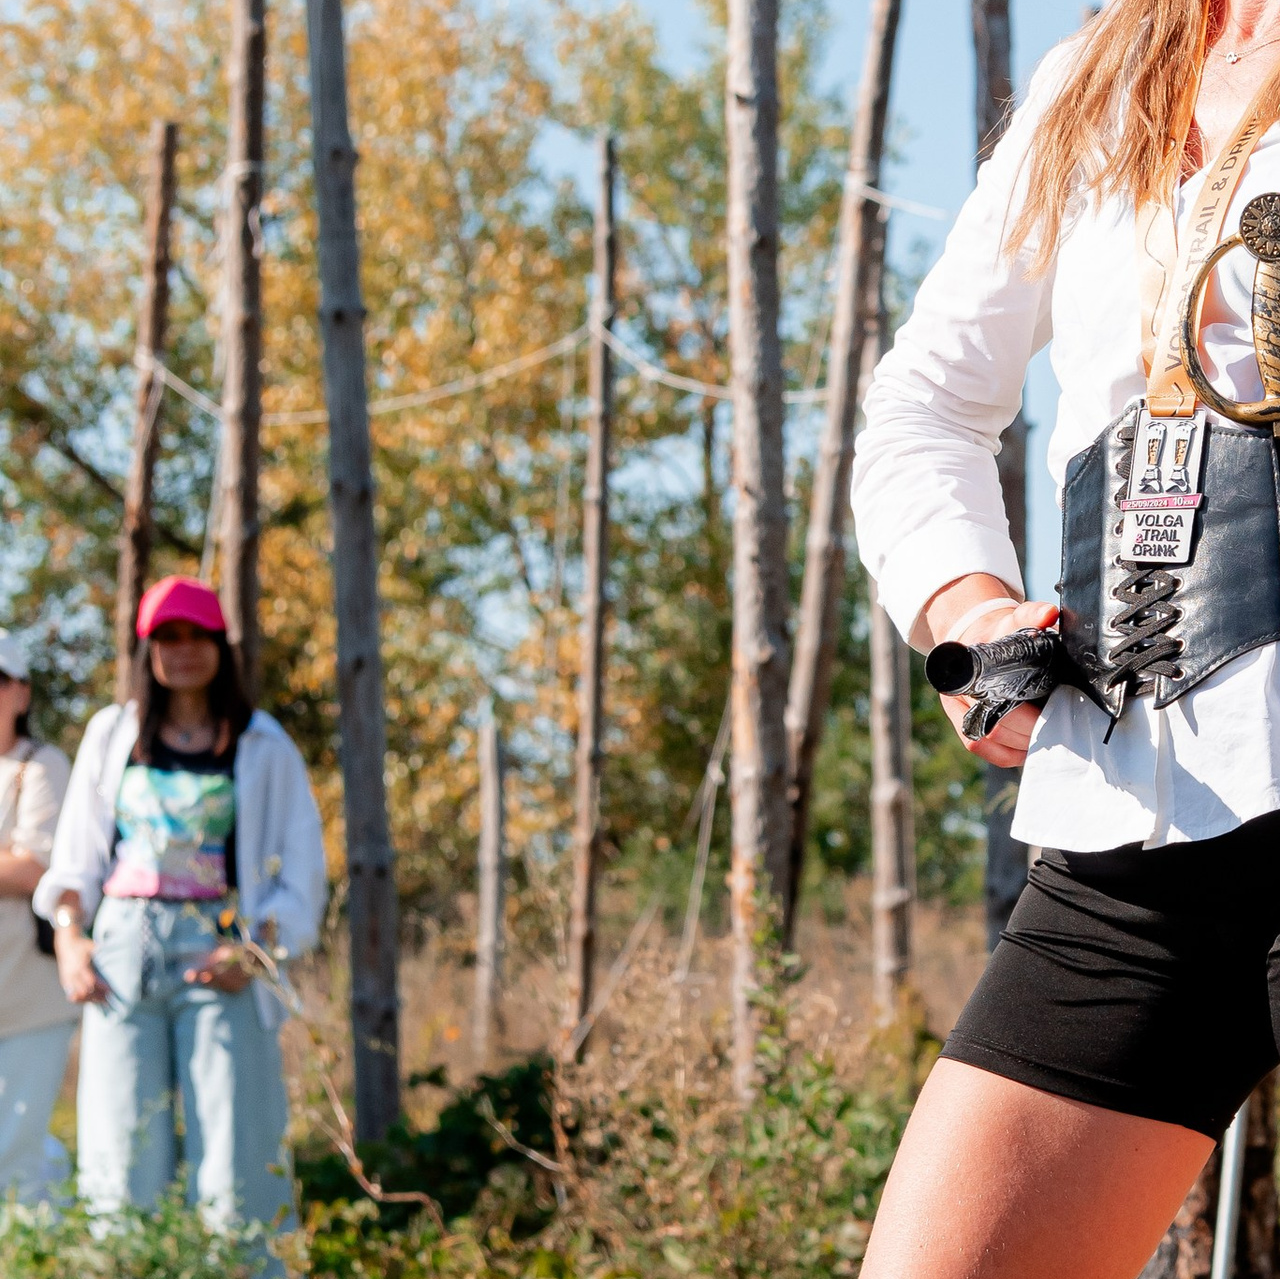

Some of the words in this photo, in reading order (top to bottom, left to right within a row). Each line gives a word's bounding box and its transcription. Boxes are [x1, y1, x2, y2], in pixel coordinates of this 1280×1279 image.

[1220, 118, 1259, 173] DRIN
[1211, 175, 1231, 192] &
[1184, 197, 1221, 272] TRAIL
[1135, 513, 1184, 528] VOLGA
[1142, 528, 1181, 543] TRAIL
[1132, 543, 1180, 558] DRINK
